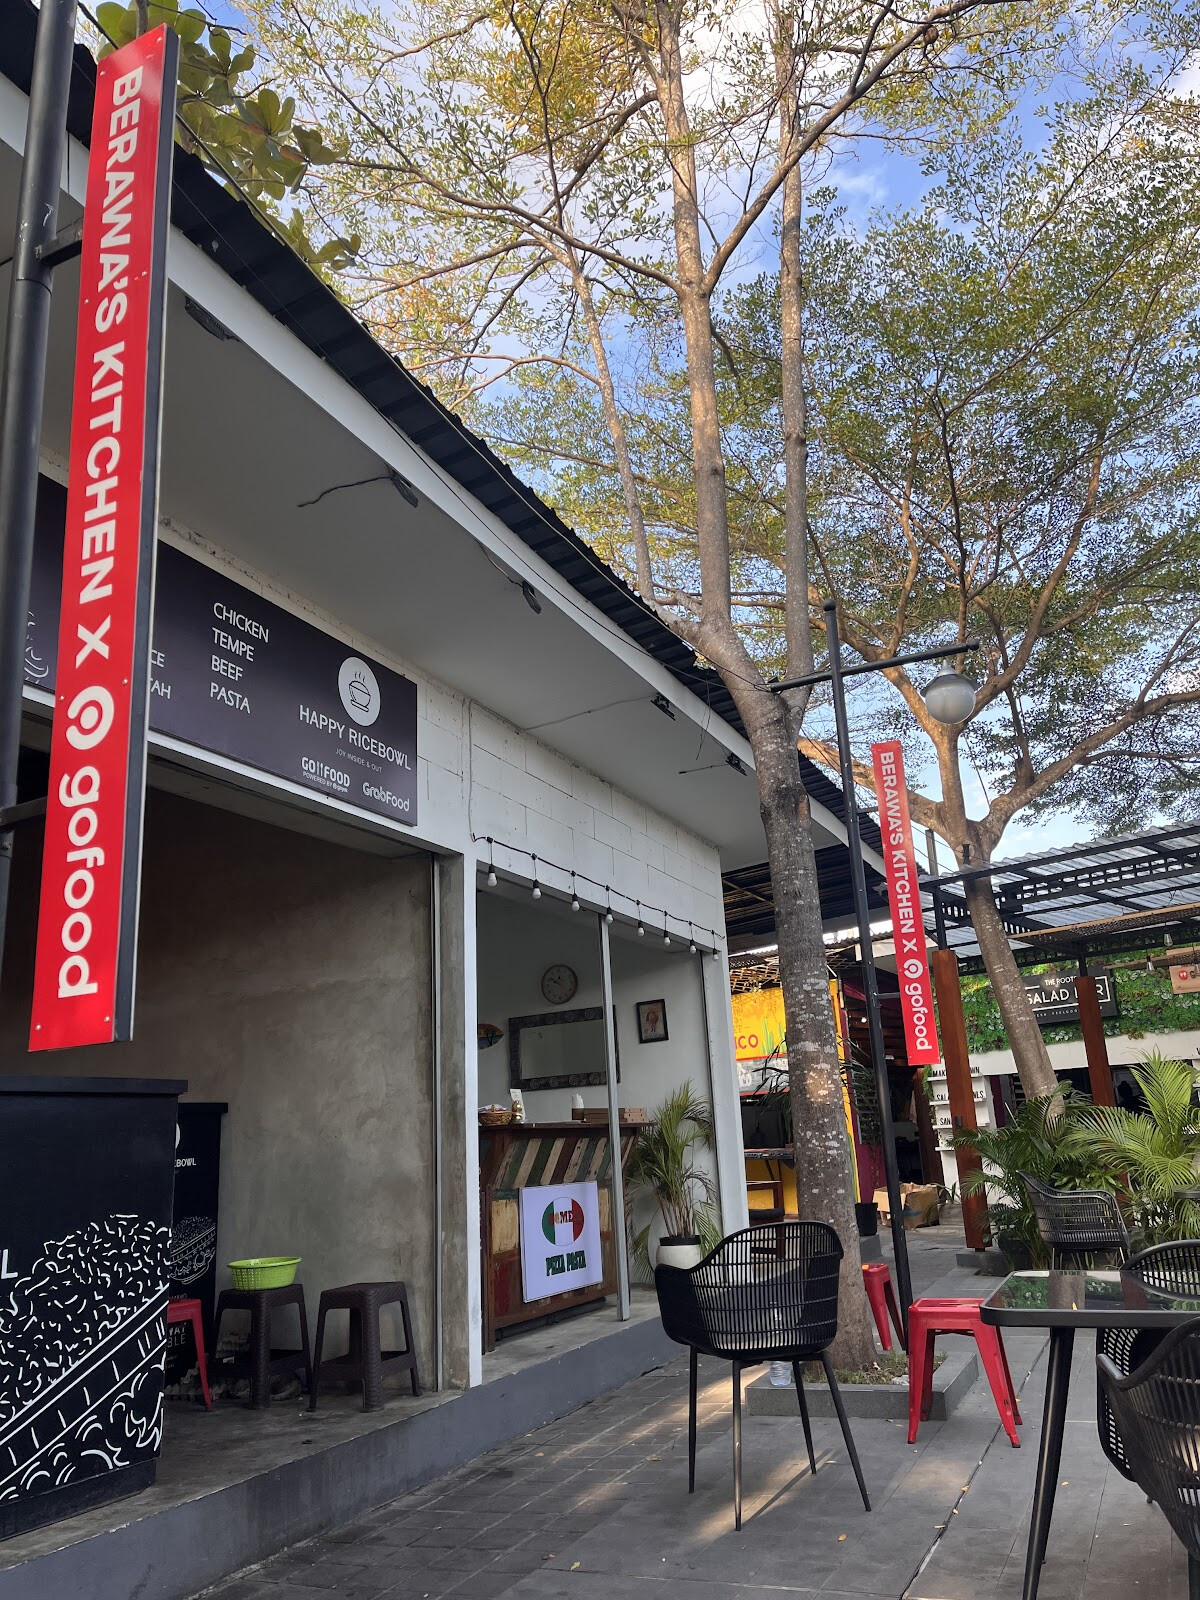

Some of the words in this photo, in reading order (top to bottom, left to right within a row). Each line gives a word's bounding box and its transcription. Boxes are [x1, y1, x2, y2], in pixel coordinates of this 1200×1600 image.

[95, 66, 143, 334] BERAWA'S
[79, 341, 125, 604] KITCHEN
[212, 627, 254, 661] TEMPE
[213, 602, 269, 643] CHICKEN
[210, 682, 250, 714] PASTA
[211, 655, 243, 681] BEEF
[299, 704, 345, 739] HAPPY
[348, 728, 411, 771] RICEBOWL
[335, 748, 346, 757] JOY
[371, 763, 382, 773] OUT
[362, 782, 409, 812] GrabFood
[880, 751, 904, 846] BERAWA'S
[58, 765, 105, 998] gofood
[891, 849, 915, 934] KITCHEN
[904, 982, 932, 1050] gofood
